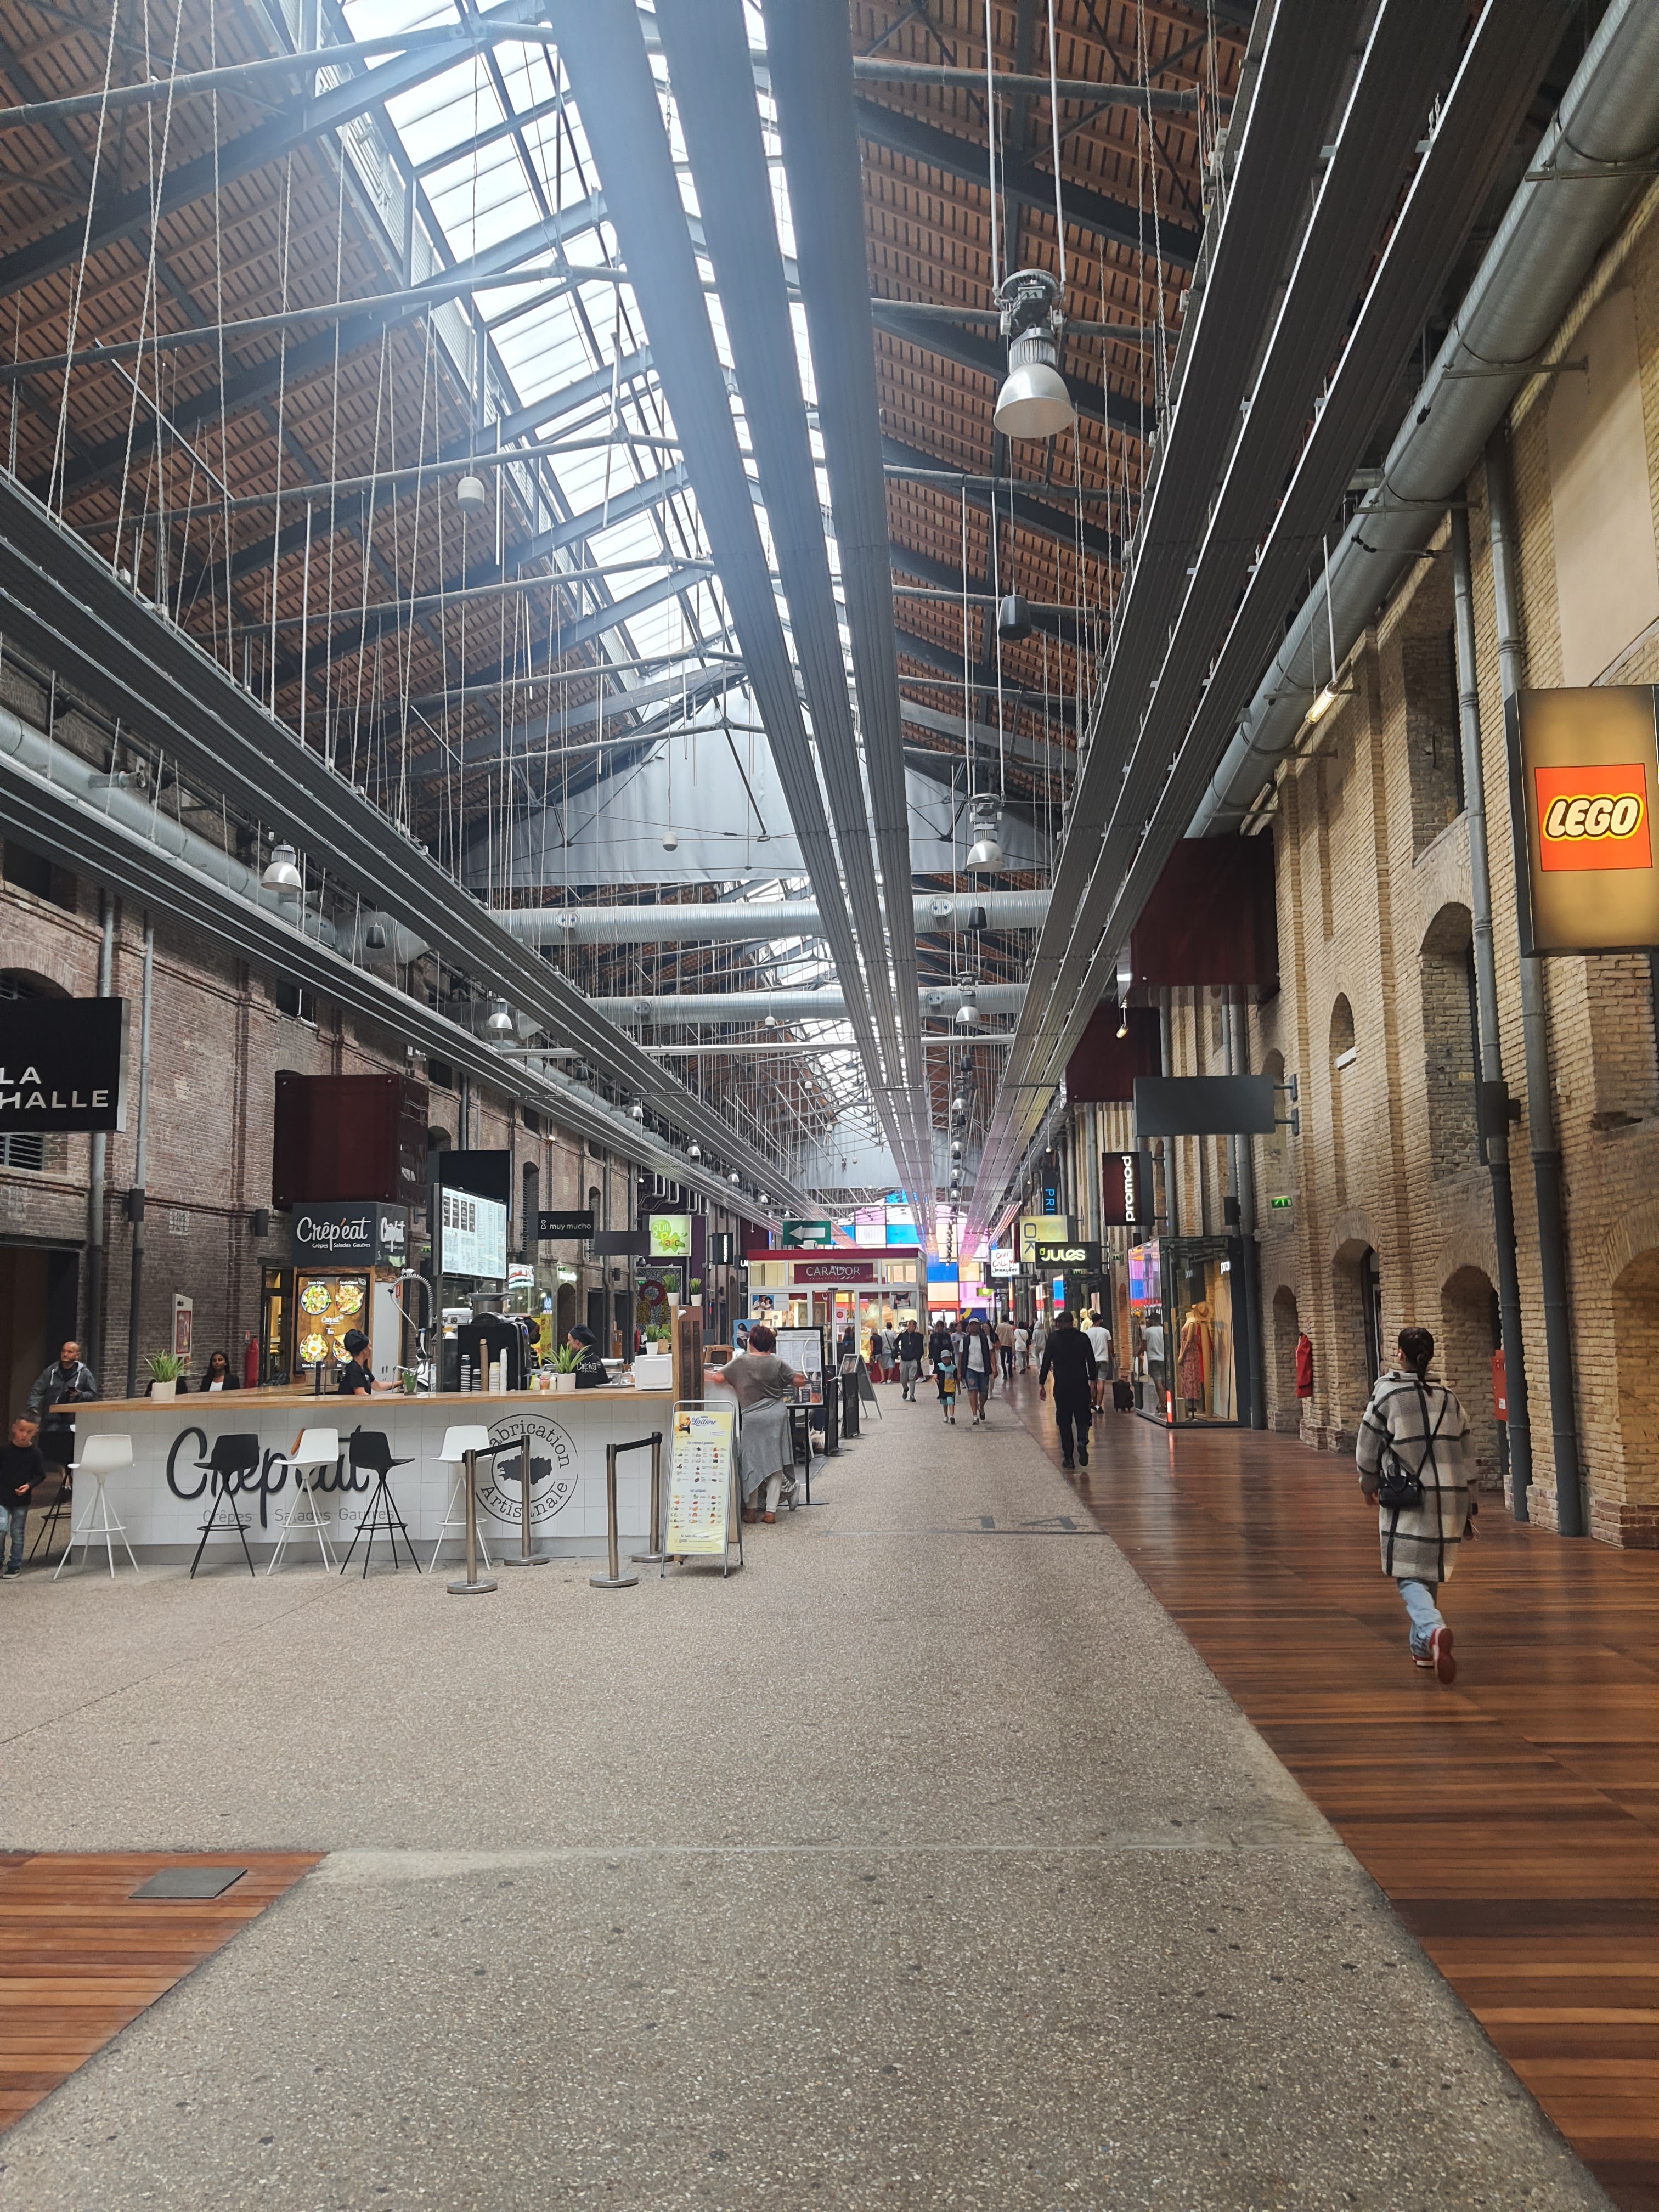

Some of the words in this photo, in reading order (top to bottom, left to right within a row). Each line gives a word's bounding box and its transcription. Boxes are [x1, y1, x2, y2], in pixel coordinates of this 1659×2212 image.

[1545, 795, 1641, 839] LEGO
[0, 1066, 41, 1085] LA
[0, 1090, 109, 1109] HALLE
[1045, 1189, 1055, 1216] PRI
[1121, 1156, 1135, 1222] promod
[661, 1232, 680, 1246] Parc
[806, 1266, 861, 1276] CARADOR
[490, 1420, 570, 1469] abrication
[481, 1482, 568, 1518] Artisnale
